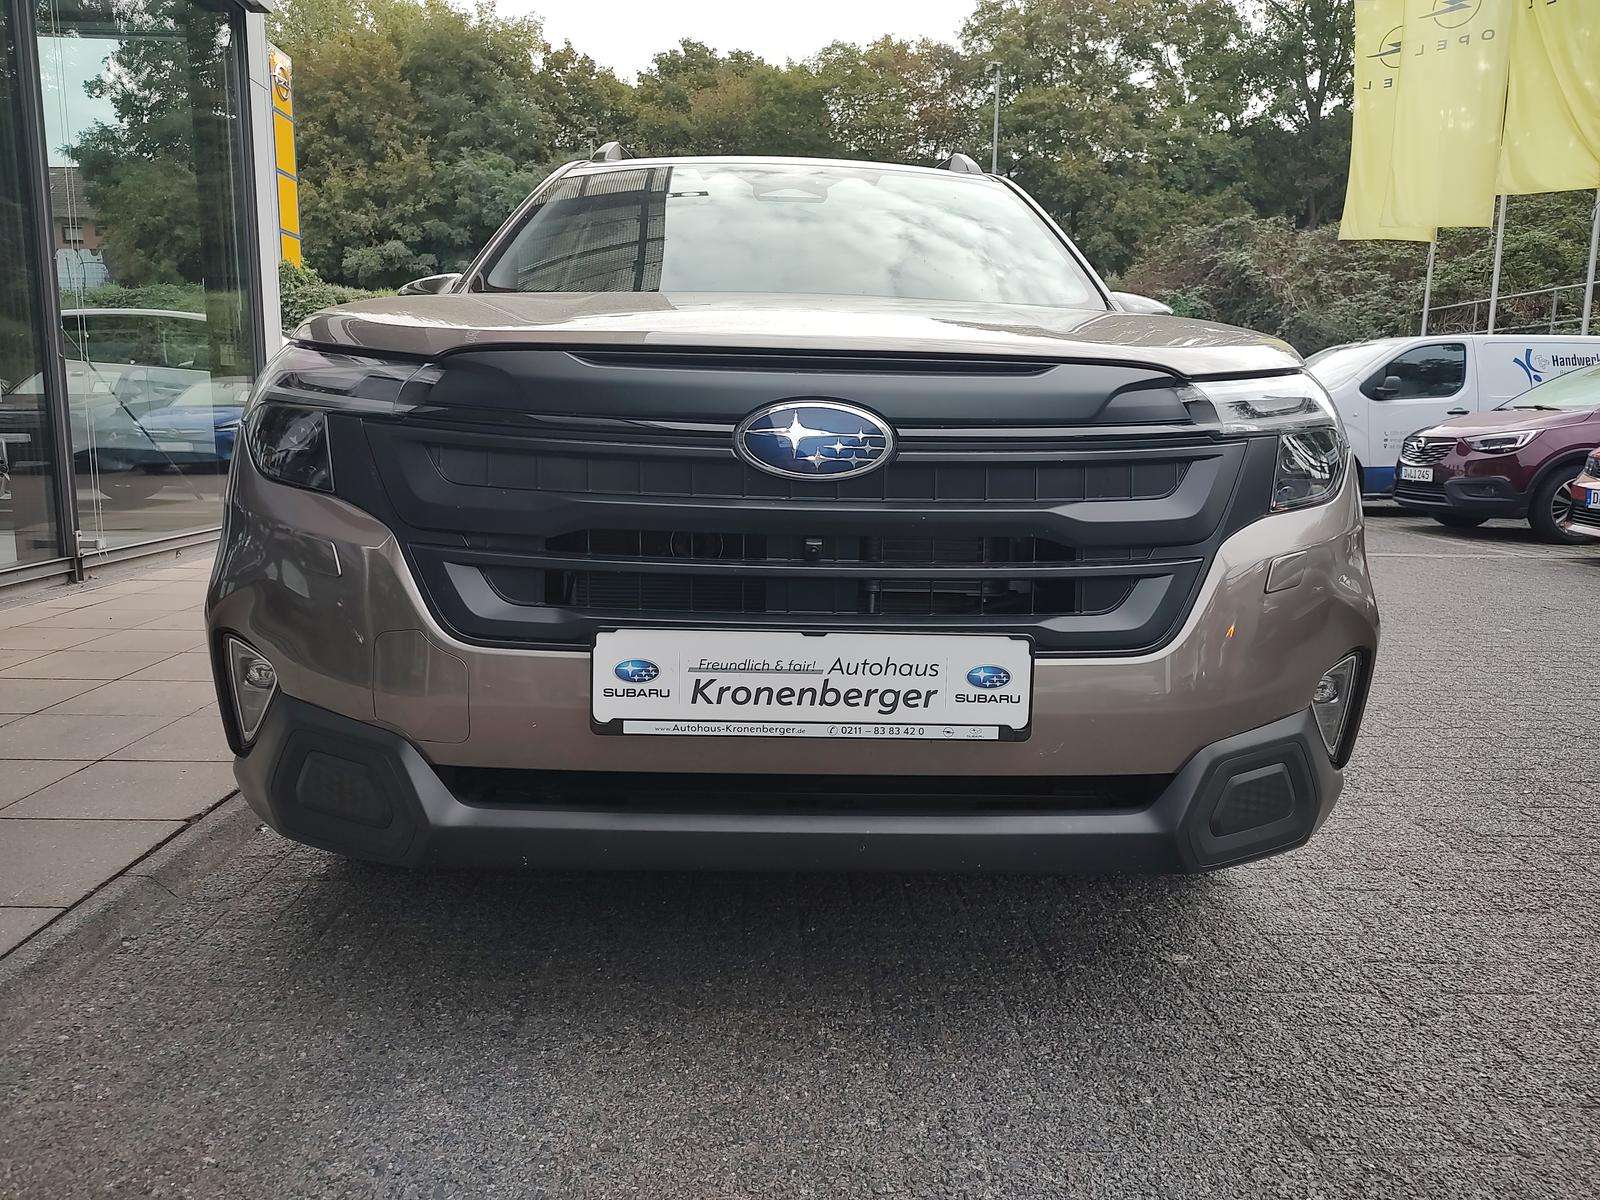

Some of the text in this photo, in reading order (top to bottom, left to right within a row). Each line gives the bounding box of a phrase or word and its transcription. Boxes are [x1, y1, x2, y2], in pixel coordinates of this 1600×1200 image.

[699, 658, 816, 673] Freundlich & fair!
[827, 656, 940, 677] Autohaus
[603, 688, 670, 698] SUBARU
[690, 678, 939, 715] Kronenberger
[955, 693, 1021, 704] SUBARU
[654, 723, 806, 736] www.Autohaus-Kronenberger.de
[841, 726, 862, 735] 0211
[873, 726, 886, 735] 83
[888, 727, 901, 736] 83
[903, 727, 916, 736] 42
[918, 727, 925, 736] 0
